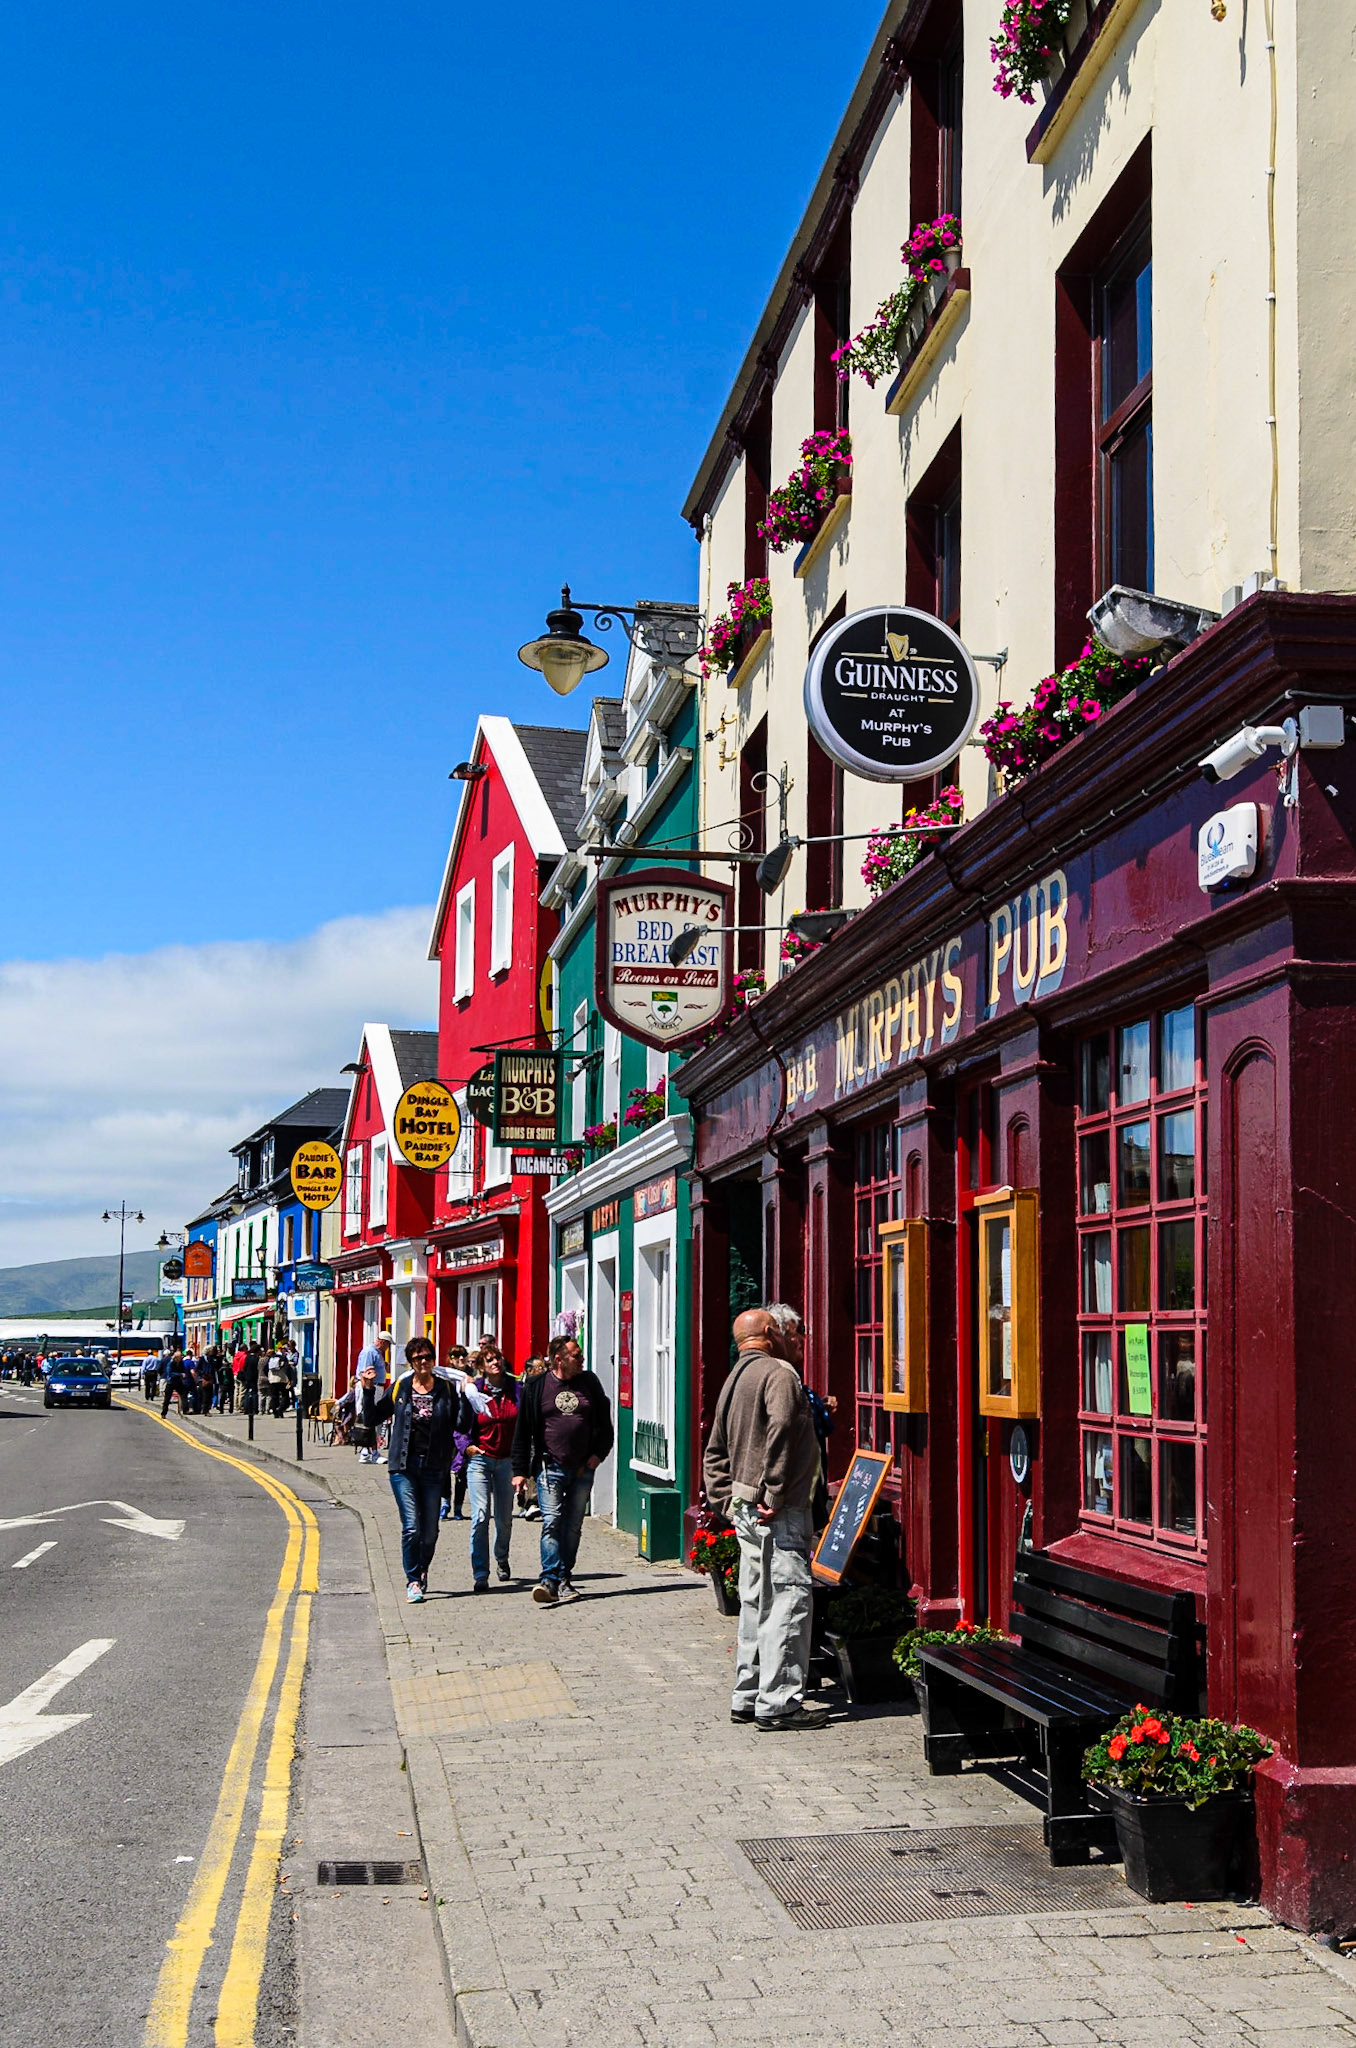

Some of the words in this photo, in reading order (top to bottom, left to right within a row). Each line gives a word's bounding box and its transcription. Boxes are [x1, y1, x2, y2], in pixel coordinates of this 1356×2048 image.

[834, 657, 959, 694] GUINNESS
[871, 691, 926, 703] DRAUGHT
[888, 708, 905, 718] AT
[882, 735, 912, 747] PUB
[612, 892, 721, 922] MURPHY'S
[637, 920, 673, 941] BED
[616, 968, 660, 984] Rooms
[682, 970, 716, 986] Suite
[835, 935, 963, 1096] MURPHY'S
[987, 869, 1069, 1008] PUB
[501, 1057, 555, 1084] MURPHYS
[407, 1094, 449, 1107] DINGLE
[500, 1086, 556, 1115] B&B
[415, 1106, 439, 1118] BAY
[399, 1117, 456, 1136] HOTEL
[536, 1127, 555, 1140] SUITE
[415, 1152, 440, 1162] BAR
[515, 1156, 569, 1175] VACANCIES
[295, 1163, 337, 1180] BAR
[303, 1192, 331, 1202] HOTEL
